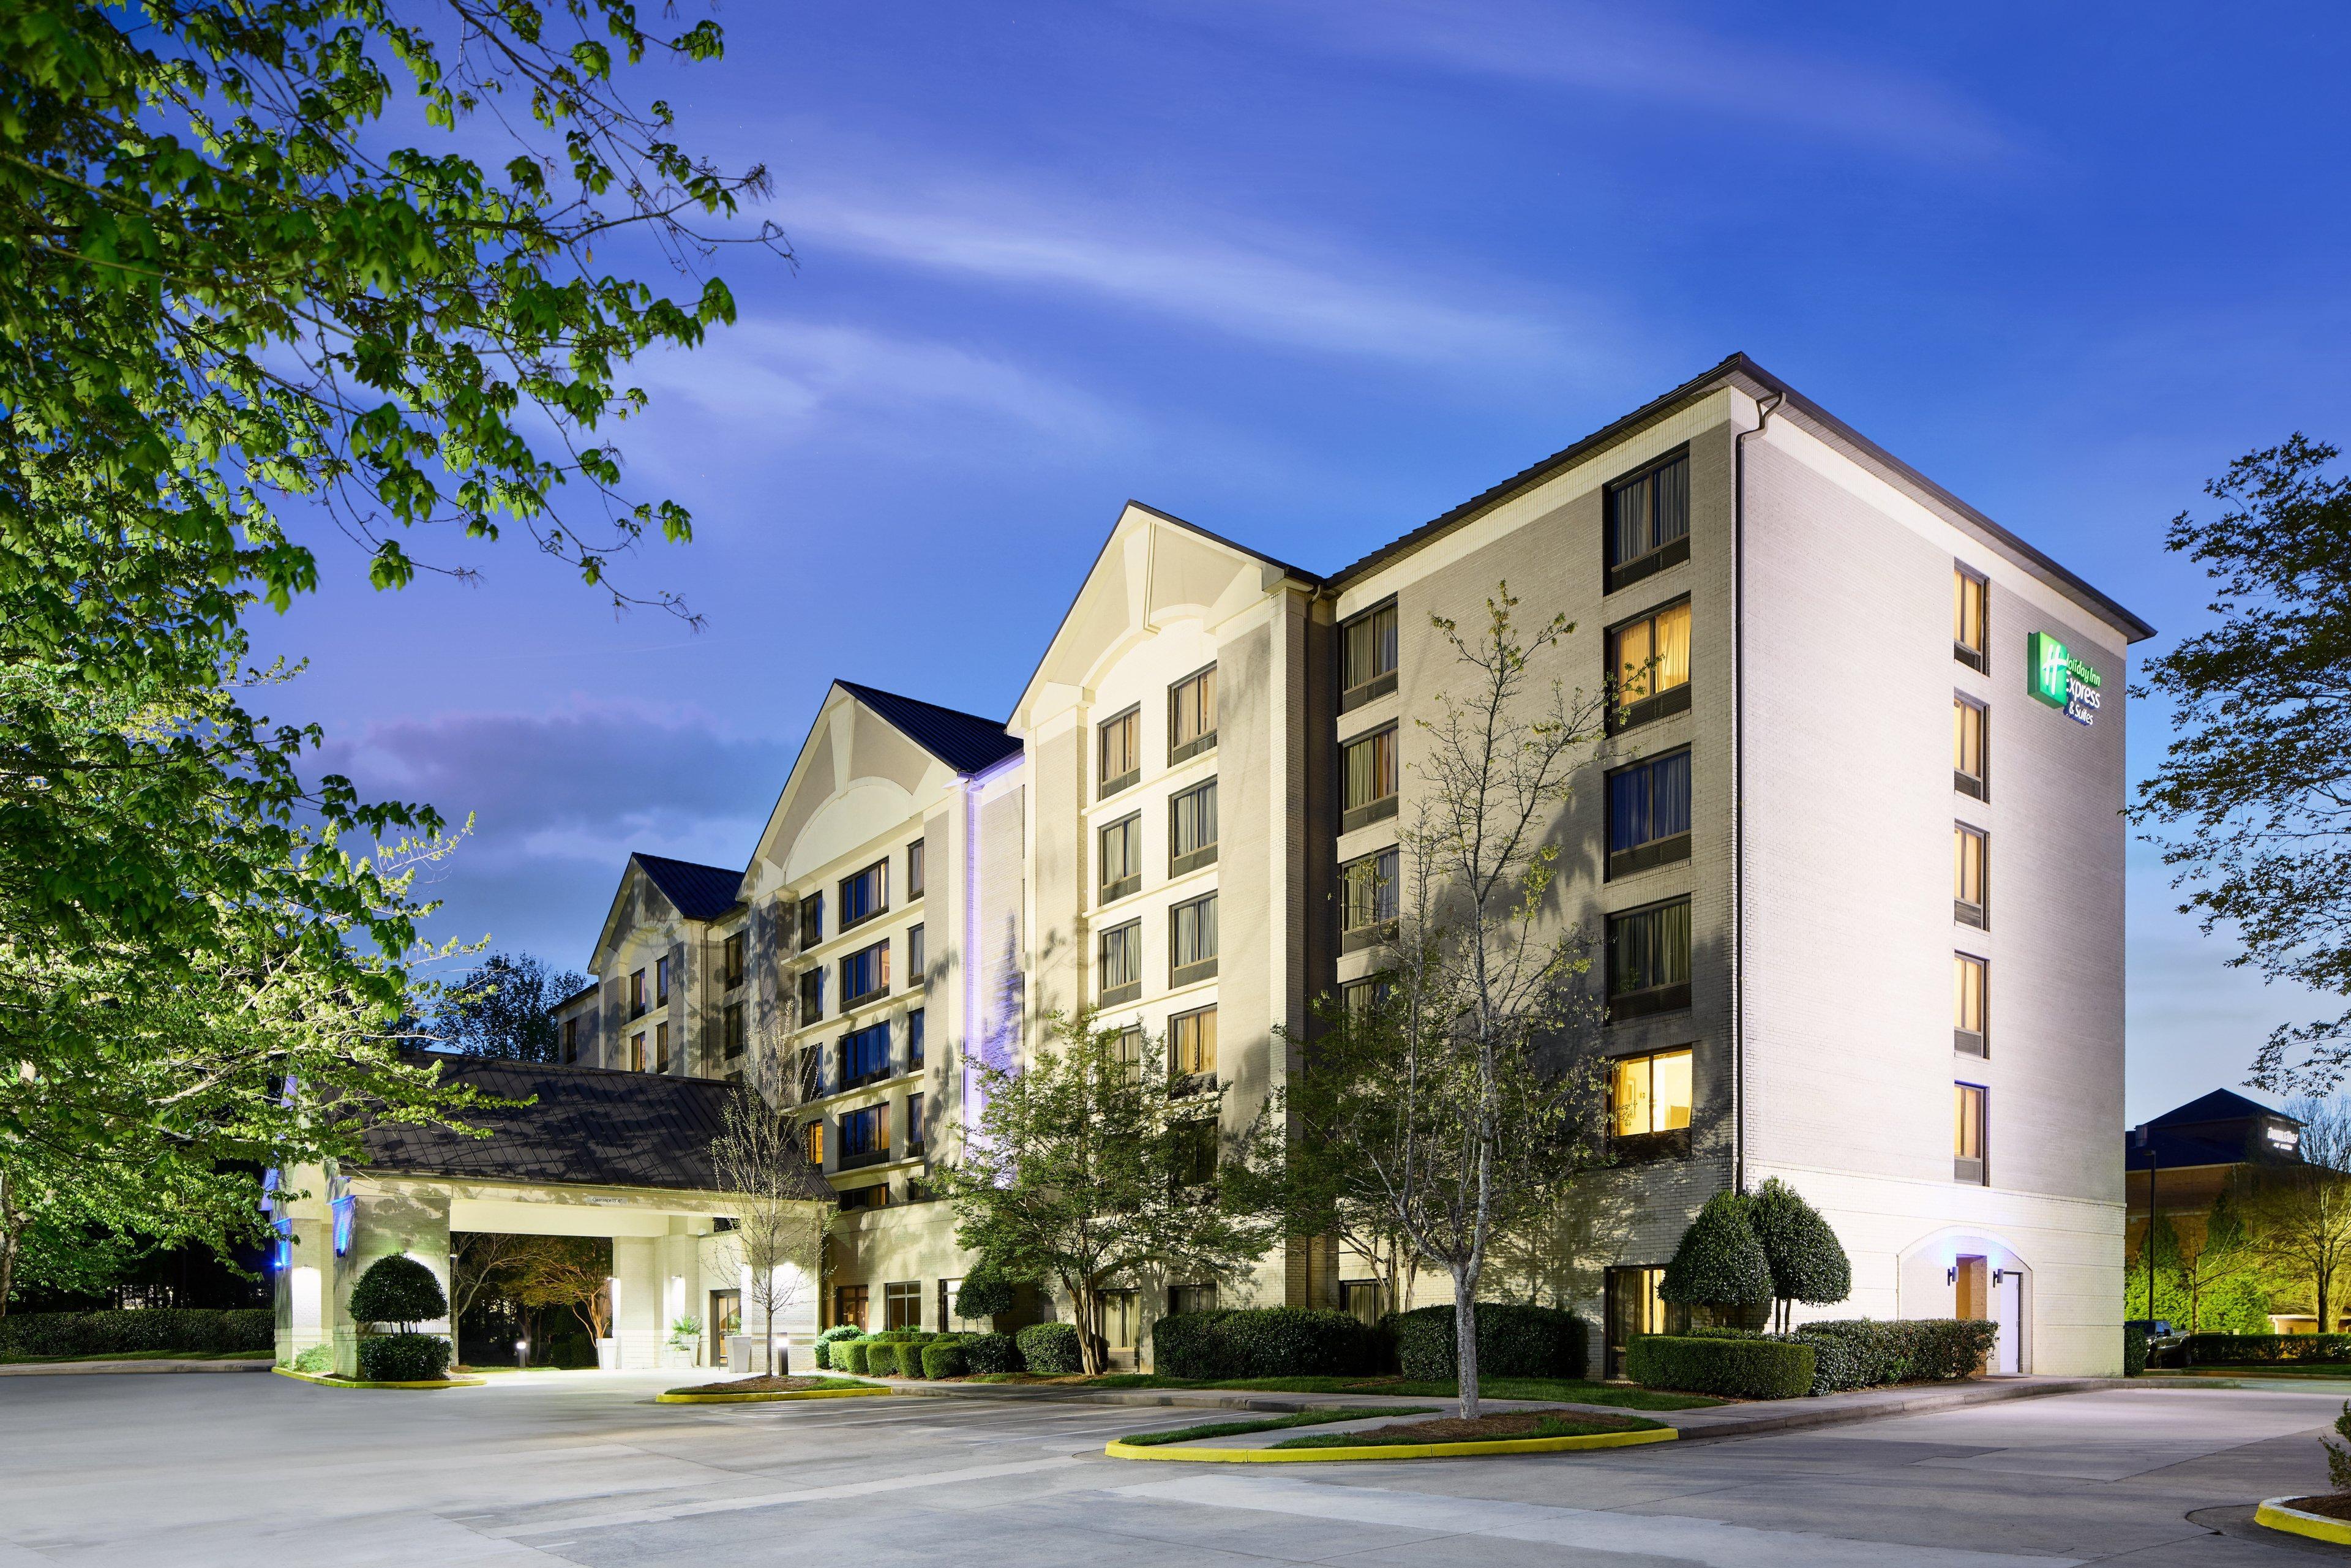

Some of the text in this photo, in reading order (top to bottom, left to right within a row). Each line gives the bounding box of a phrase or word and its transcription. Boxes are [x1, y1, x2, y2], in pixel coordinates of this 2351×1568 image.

[2090, 667, 2101, 686] Inn
[2069, 701, 2093, 726] & Suites
